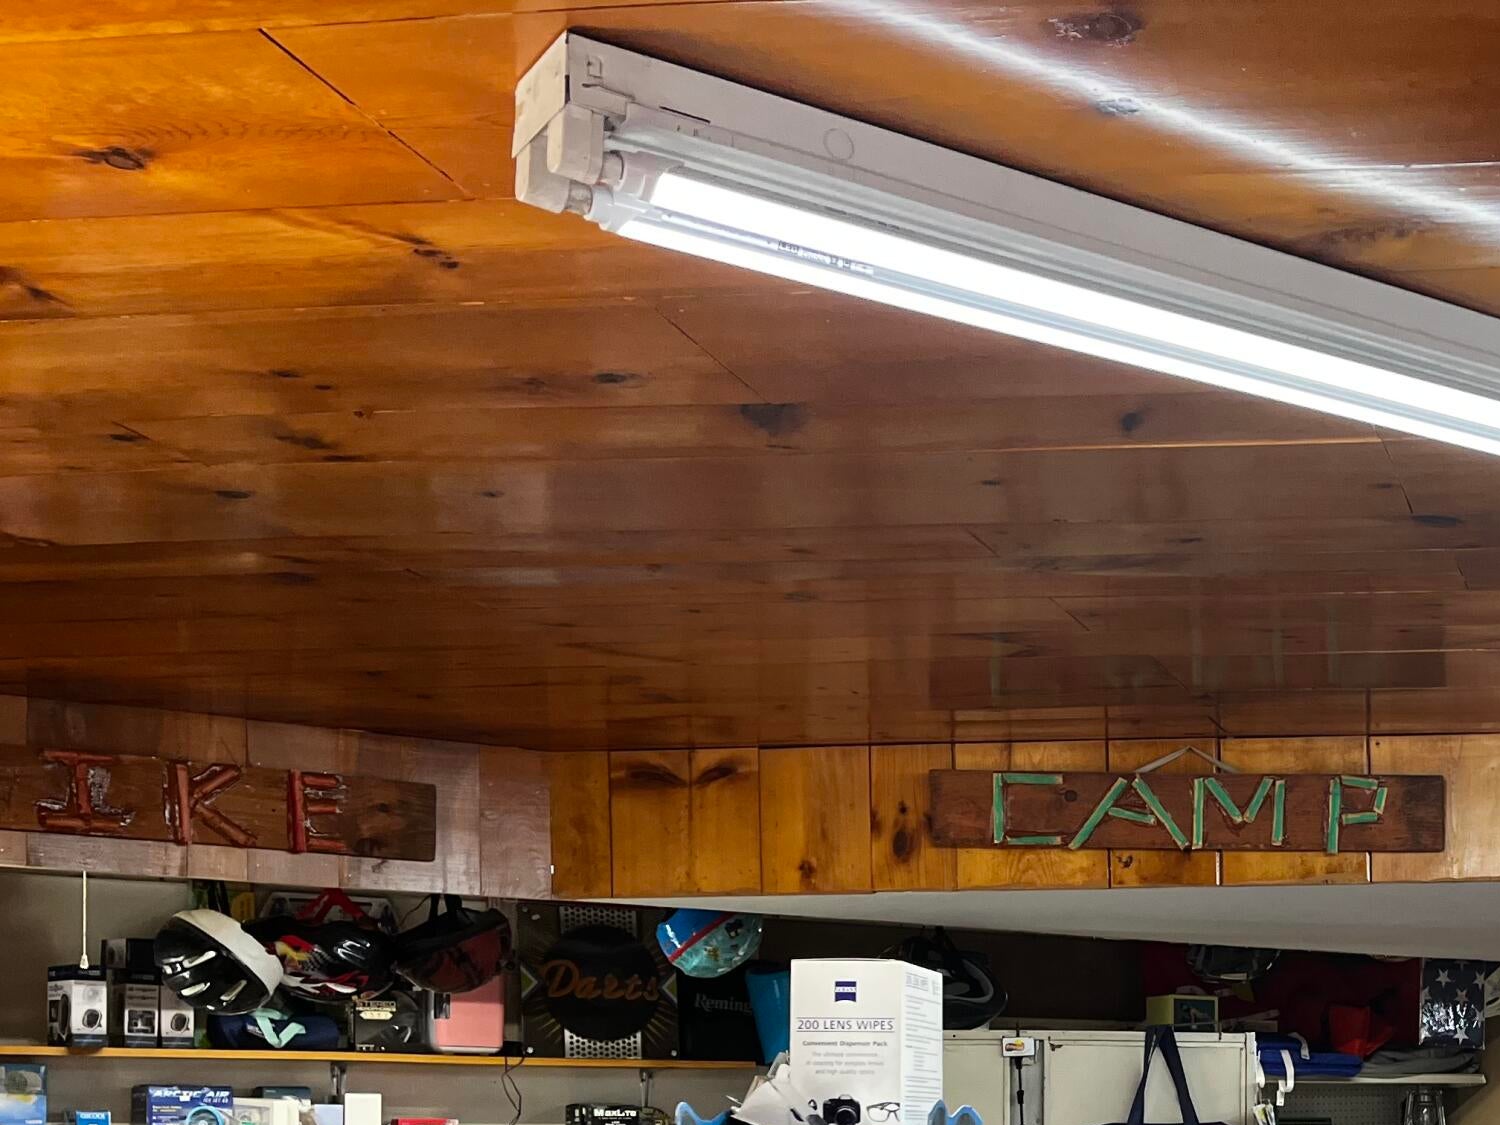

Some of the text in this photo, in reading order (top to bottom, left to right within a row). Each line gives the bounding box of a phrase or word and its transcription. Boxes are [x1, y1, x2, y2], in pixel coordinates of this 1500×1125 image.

[992, 772, 1388, 854] CAMP
[546, 959, 660, 999] Darts
[694, 993, 754, 1013] Reming
[797, 1020, 894, 1030] 200 LENS WIPES
[839, 1040, 870, 1048] Dispenser
[152, 1089, 230, 1099] ARCTIC AIR
